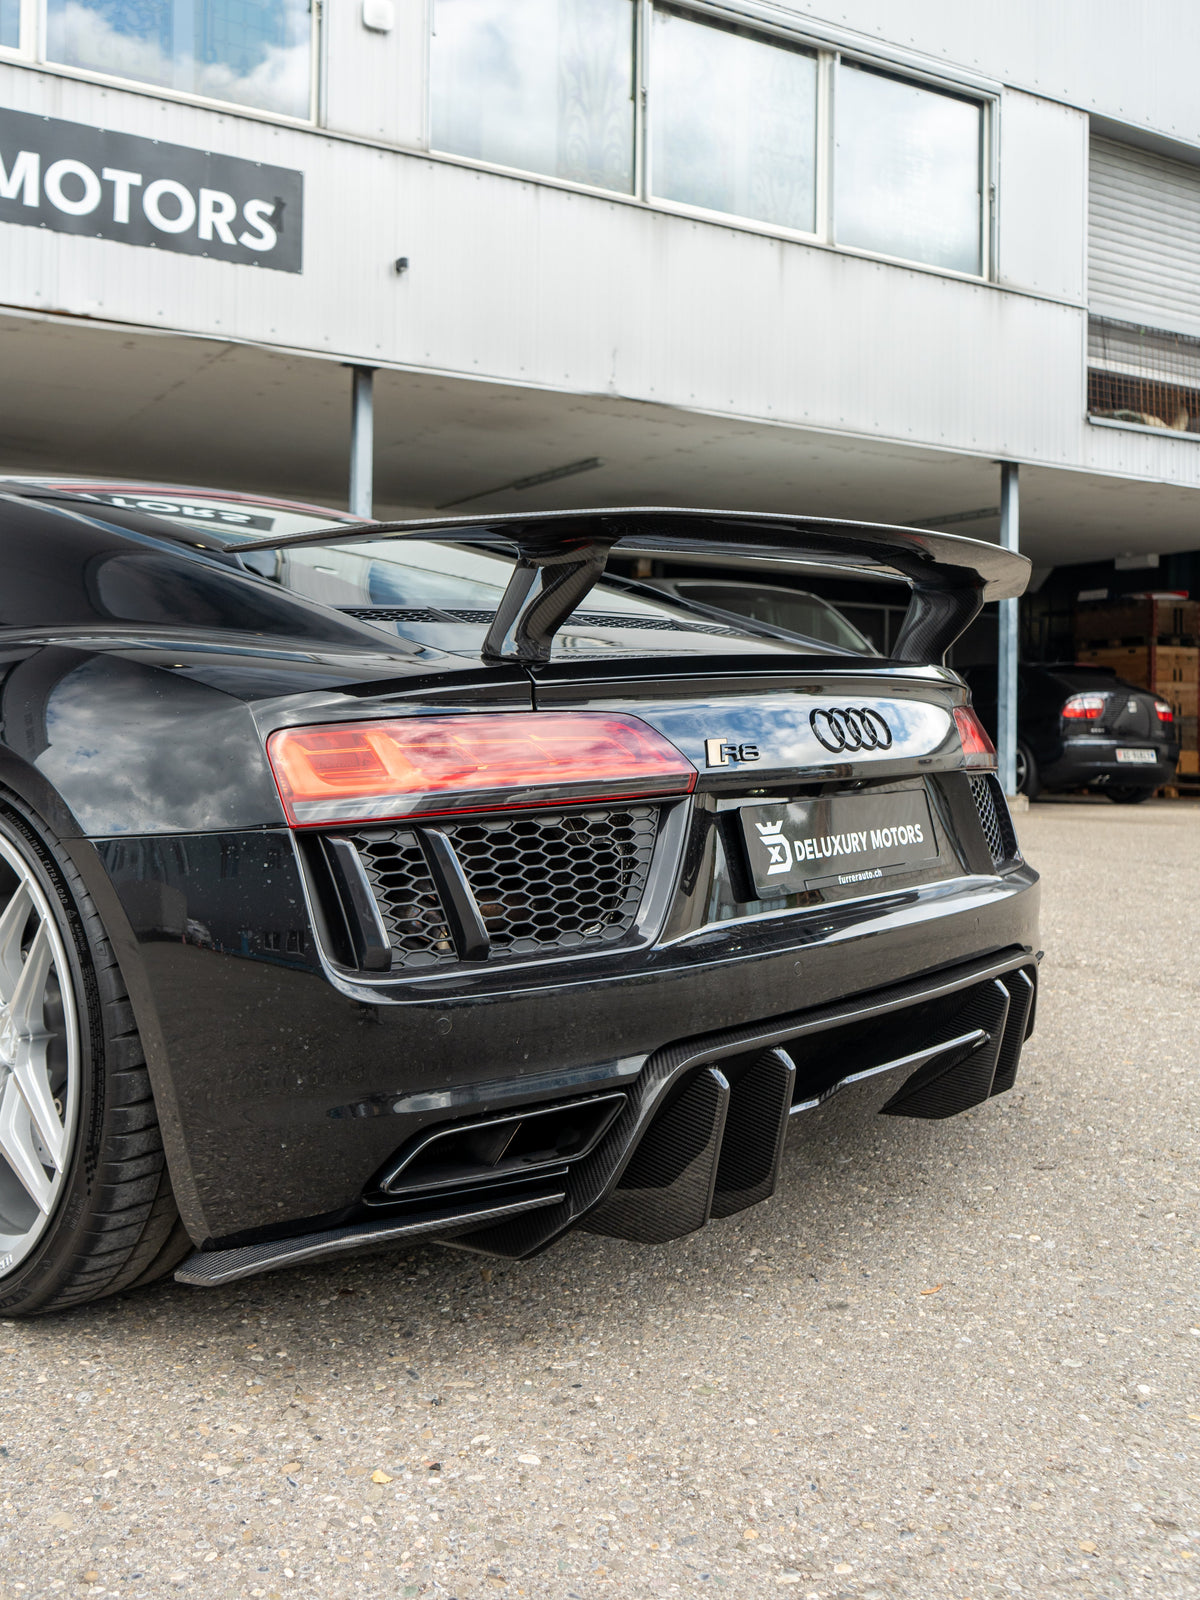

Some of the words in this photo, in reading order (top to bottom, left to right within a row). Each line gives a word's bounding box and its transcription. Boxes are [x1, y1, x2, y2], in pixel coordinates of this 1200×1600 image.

[0, 150, 278, 252] MOTORS
[719, 742, 762, 763] R8
[794, 831, 867, 862] DELUXURY
[869, 823, 924, 850] MOTORS
[43, 860, 59, 883] EXTRA
[55, 883, 68, 904] LOAD
[838, 868, 882, 885] furrerauto.ch
